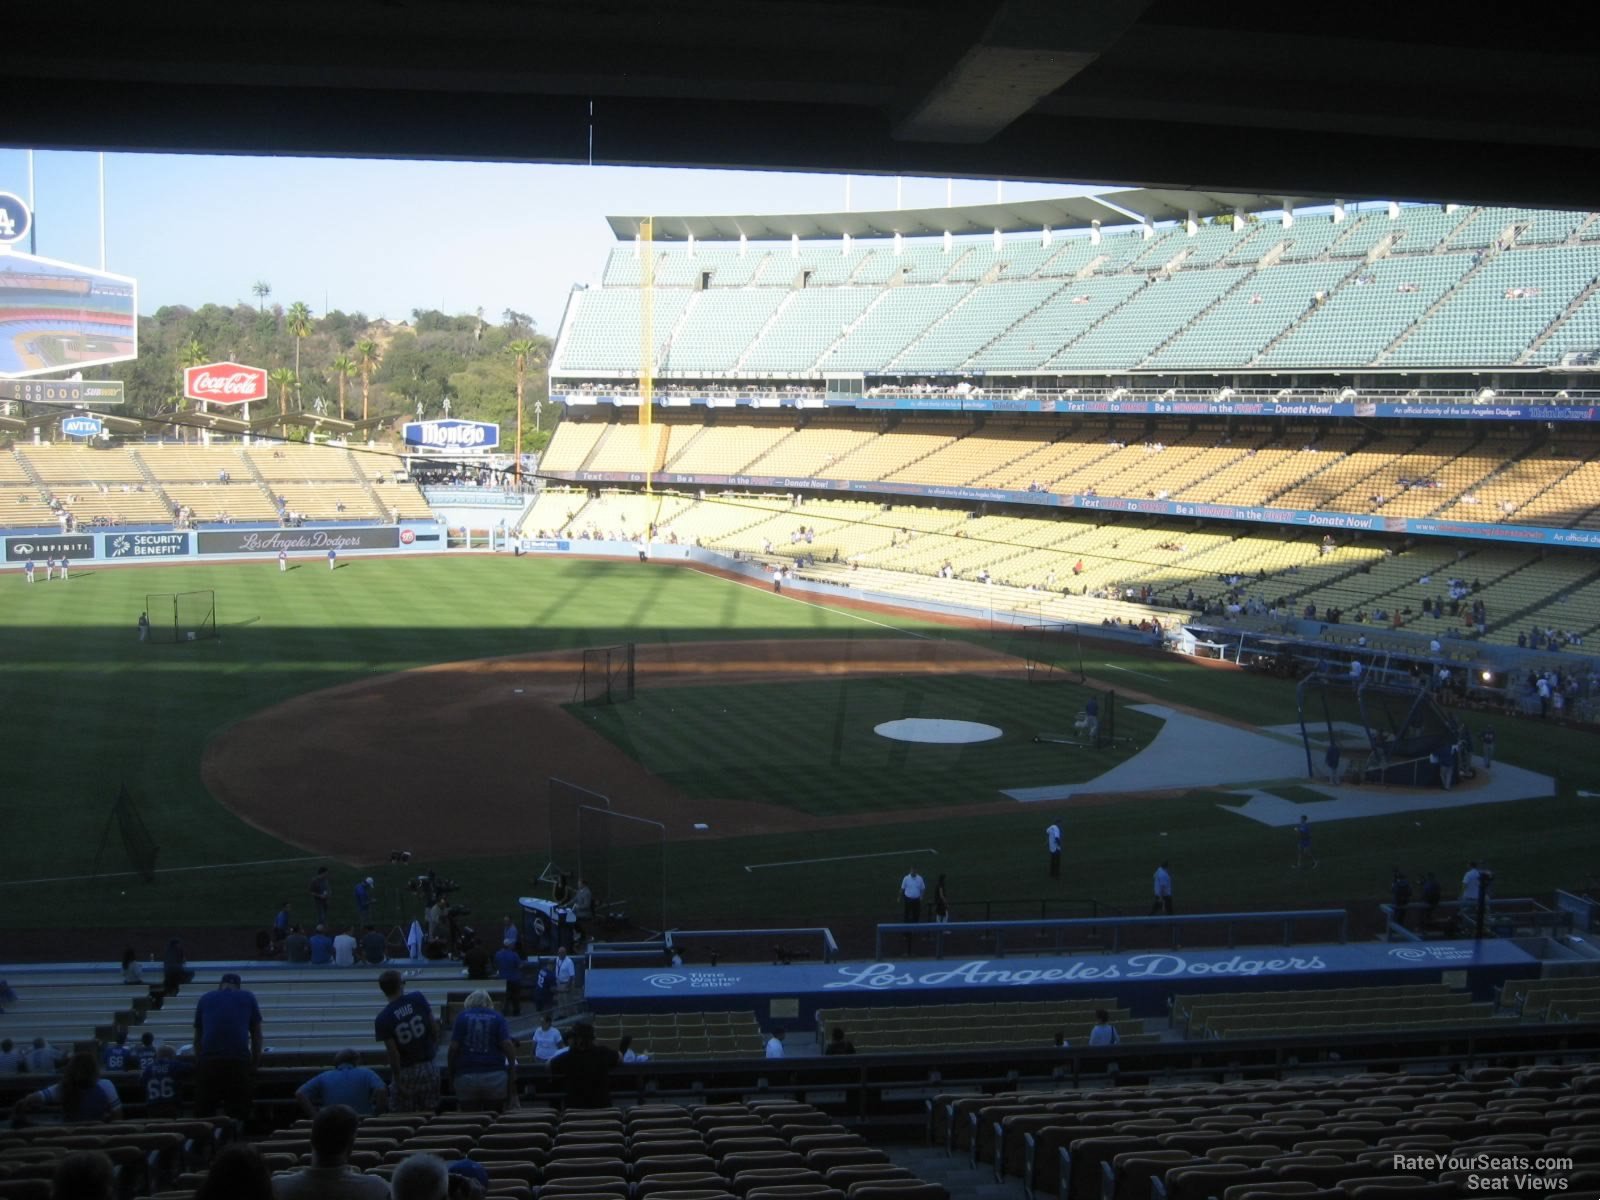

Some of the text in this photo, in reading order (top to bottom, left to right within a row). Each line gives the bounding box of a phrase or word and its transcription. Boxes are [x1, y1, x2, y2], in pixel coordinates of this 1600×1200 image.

[193, 372, 258, 394] Coca-Cola
[84, 388, 121, 396] SUBWAY
[1068, 402, 1085, 411] Text
[1111, 403, 1120, 412] to
[1155, 403, 1165, 412] Be
[1209, 403, 1217, 413] in
[1218, 403, 1232, 413] the
[1275, 404, 1308, 415] Donate
[1309, 405, 1332, 415] Now!
[1403, 406, 1422, 414] official
[1423, 406, 1442, 416] charity
[1471, 408, 1494, 417] Angeles
[1496, 408, 1521, 417] Dodgers
[66, 422, 98, 431] AVITA
[421, 424, 484, 446] Montejo
[583, 472, 602, 480] Text
[784, 478, 809, 487] Donate
[1082, 497, 1100, 507] Text
[1128, 502, 1138, 511] to
[1176, 505, 1187, 515] Be
[1236, 508, 1244, 518] in
[1246, 509, 1261, 520] the
[1309, 514, 1344, 526] Donate
[1346, 517, 1372, 528] Now!
[134, 535, 184, 546] SECURITY
[239, 531, 361, 551] Los Angeles Dodgers
[1554, 532, 1563, 542] An
[1566, 533, 1588, 544] official
[36, 543, 89, 552] INFINITI
[823, 954, 1327, 991] Los Angeles Dodgers
[393, 1003, 413, 1020] PUIG
[394, 1016, 425, 1045] 66
[146, 1077, 175, 1101] 66
